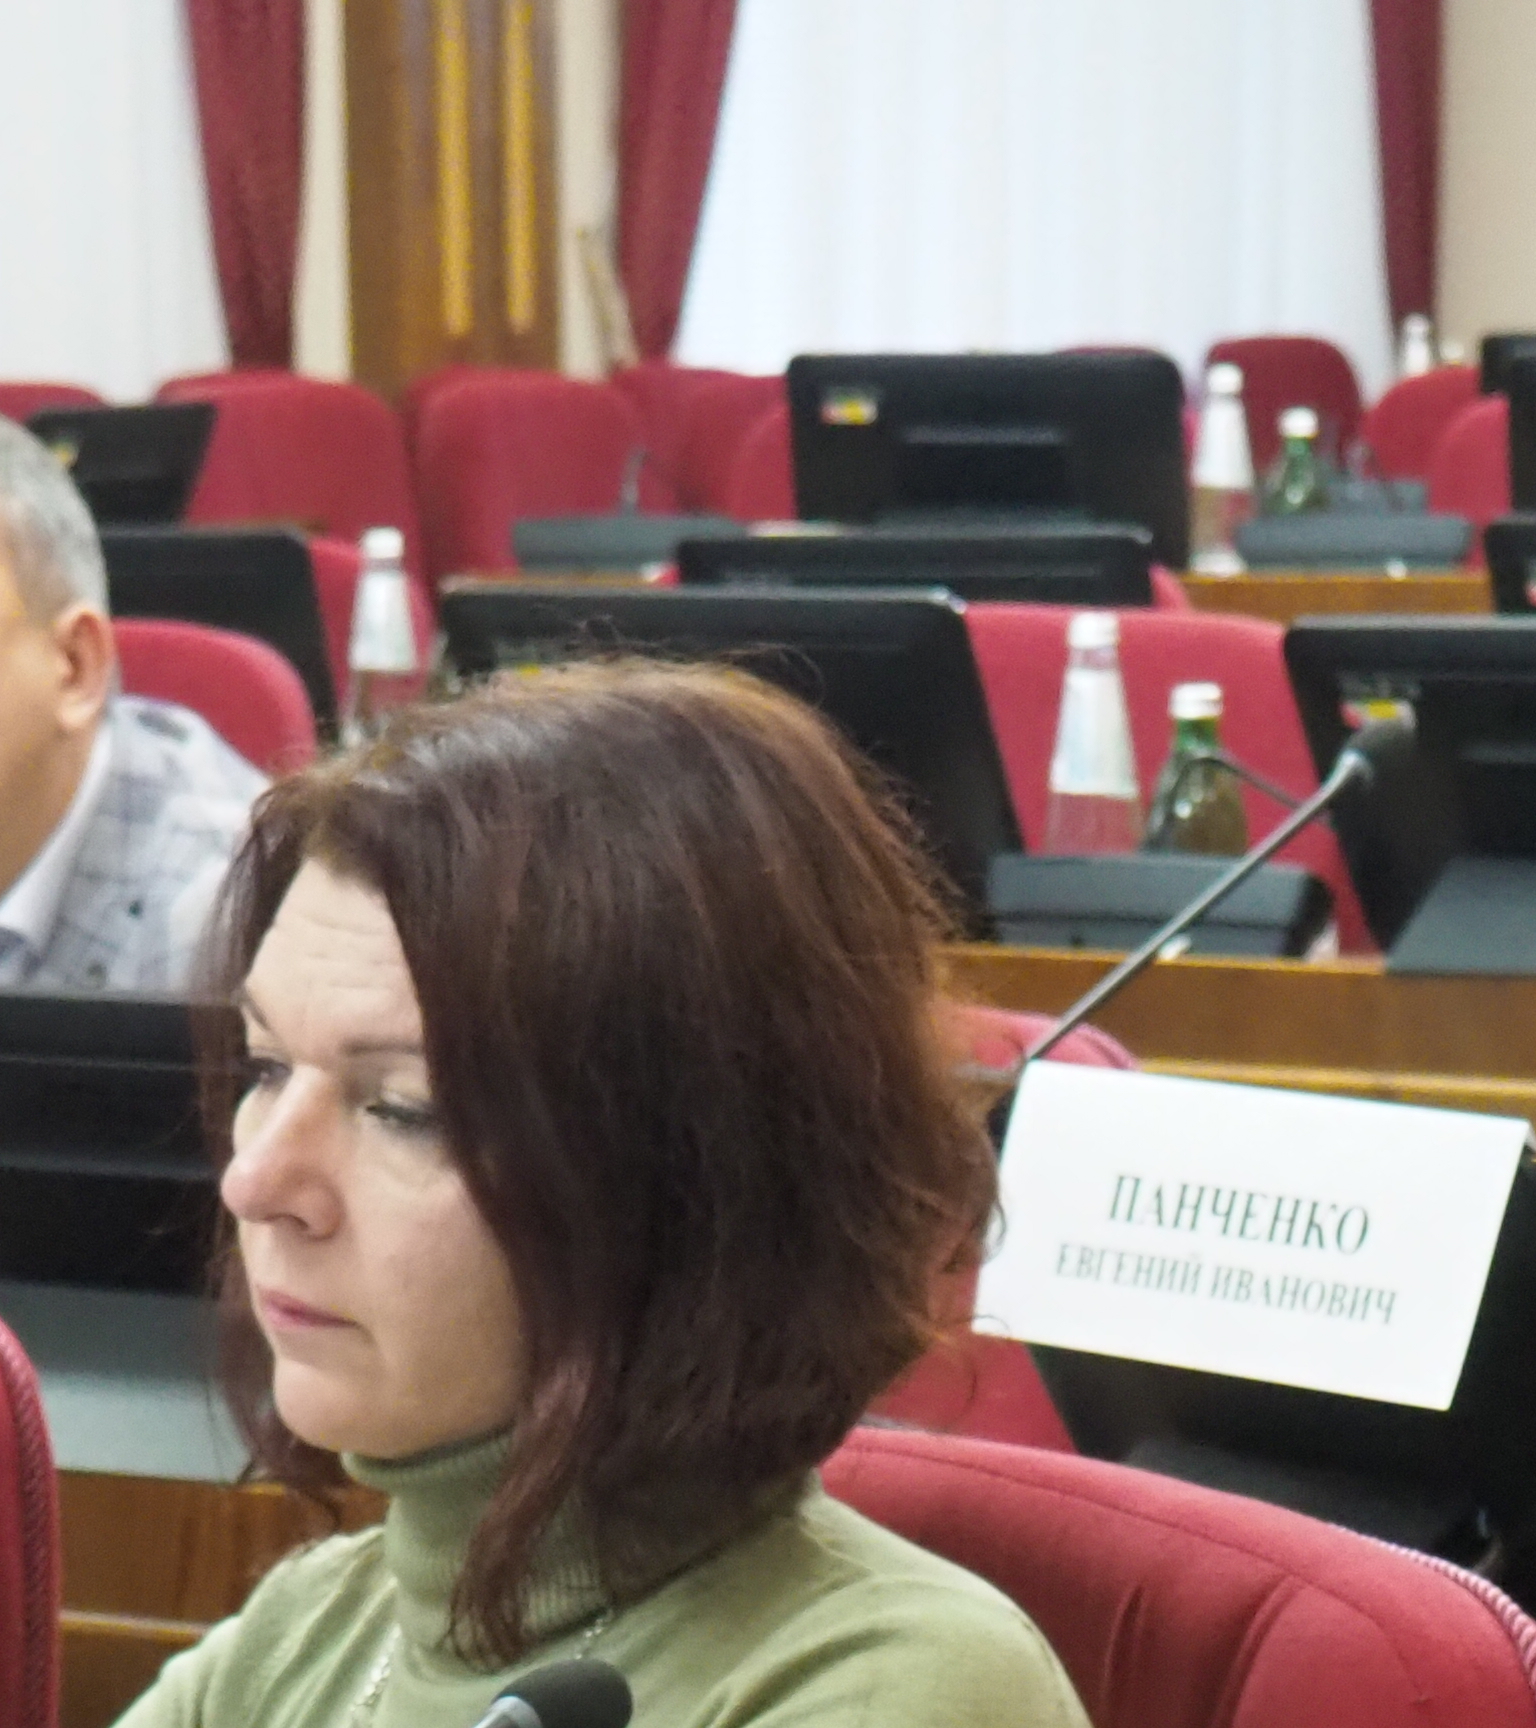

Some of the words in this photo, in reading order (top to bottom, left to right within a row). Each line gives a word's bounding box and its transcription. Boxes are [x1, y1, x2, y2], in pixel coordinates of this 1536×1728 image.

[1108, 1174, 1370, 1257] ПАНЧЕНКО
[1054, 1242, 1202, 1296] ЕВГЕНИЙ
[1208, 1266, 1398, 1326] ИВАНОВИЧ
